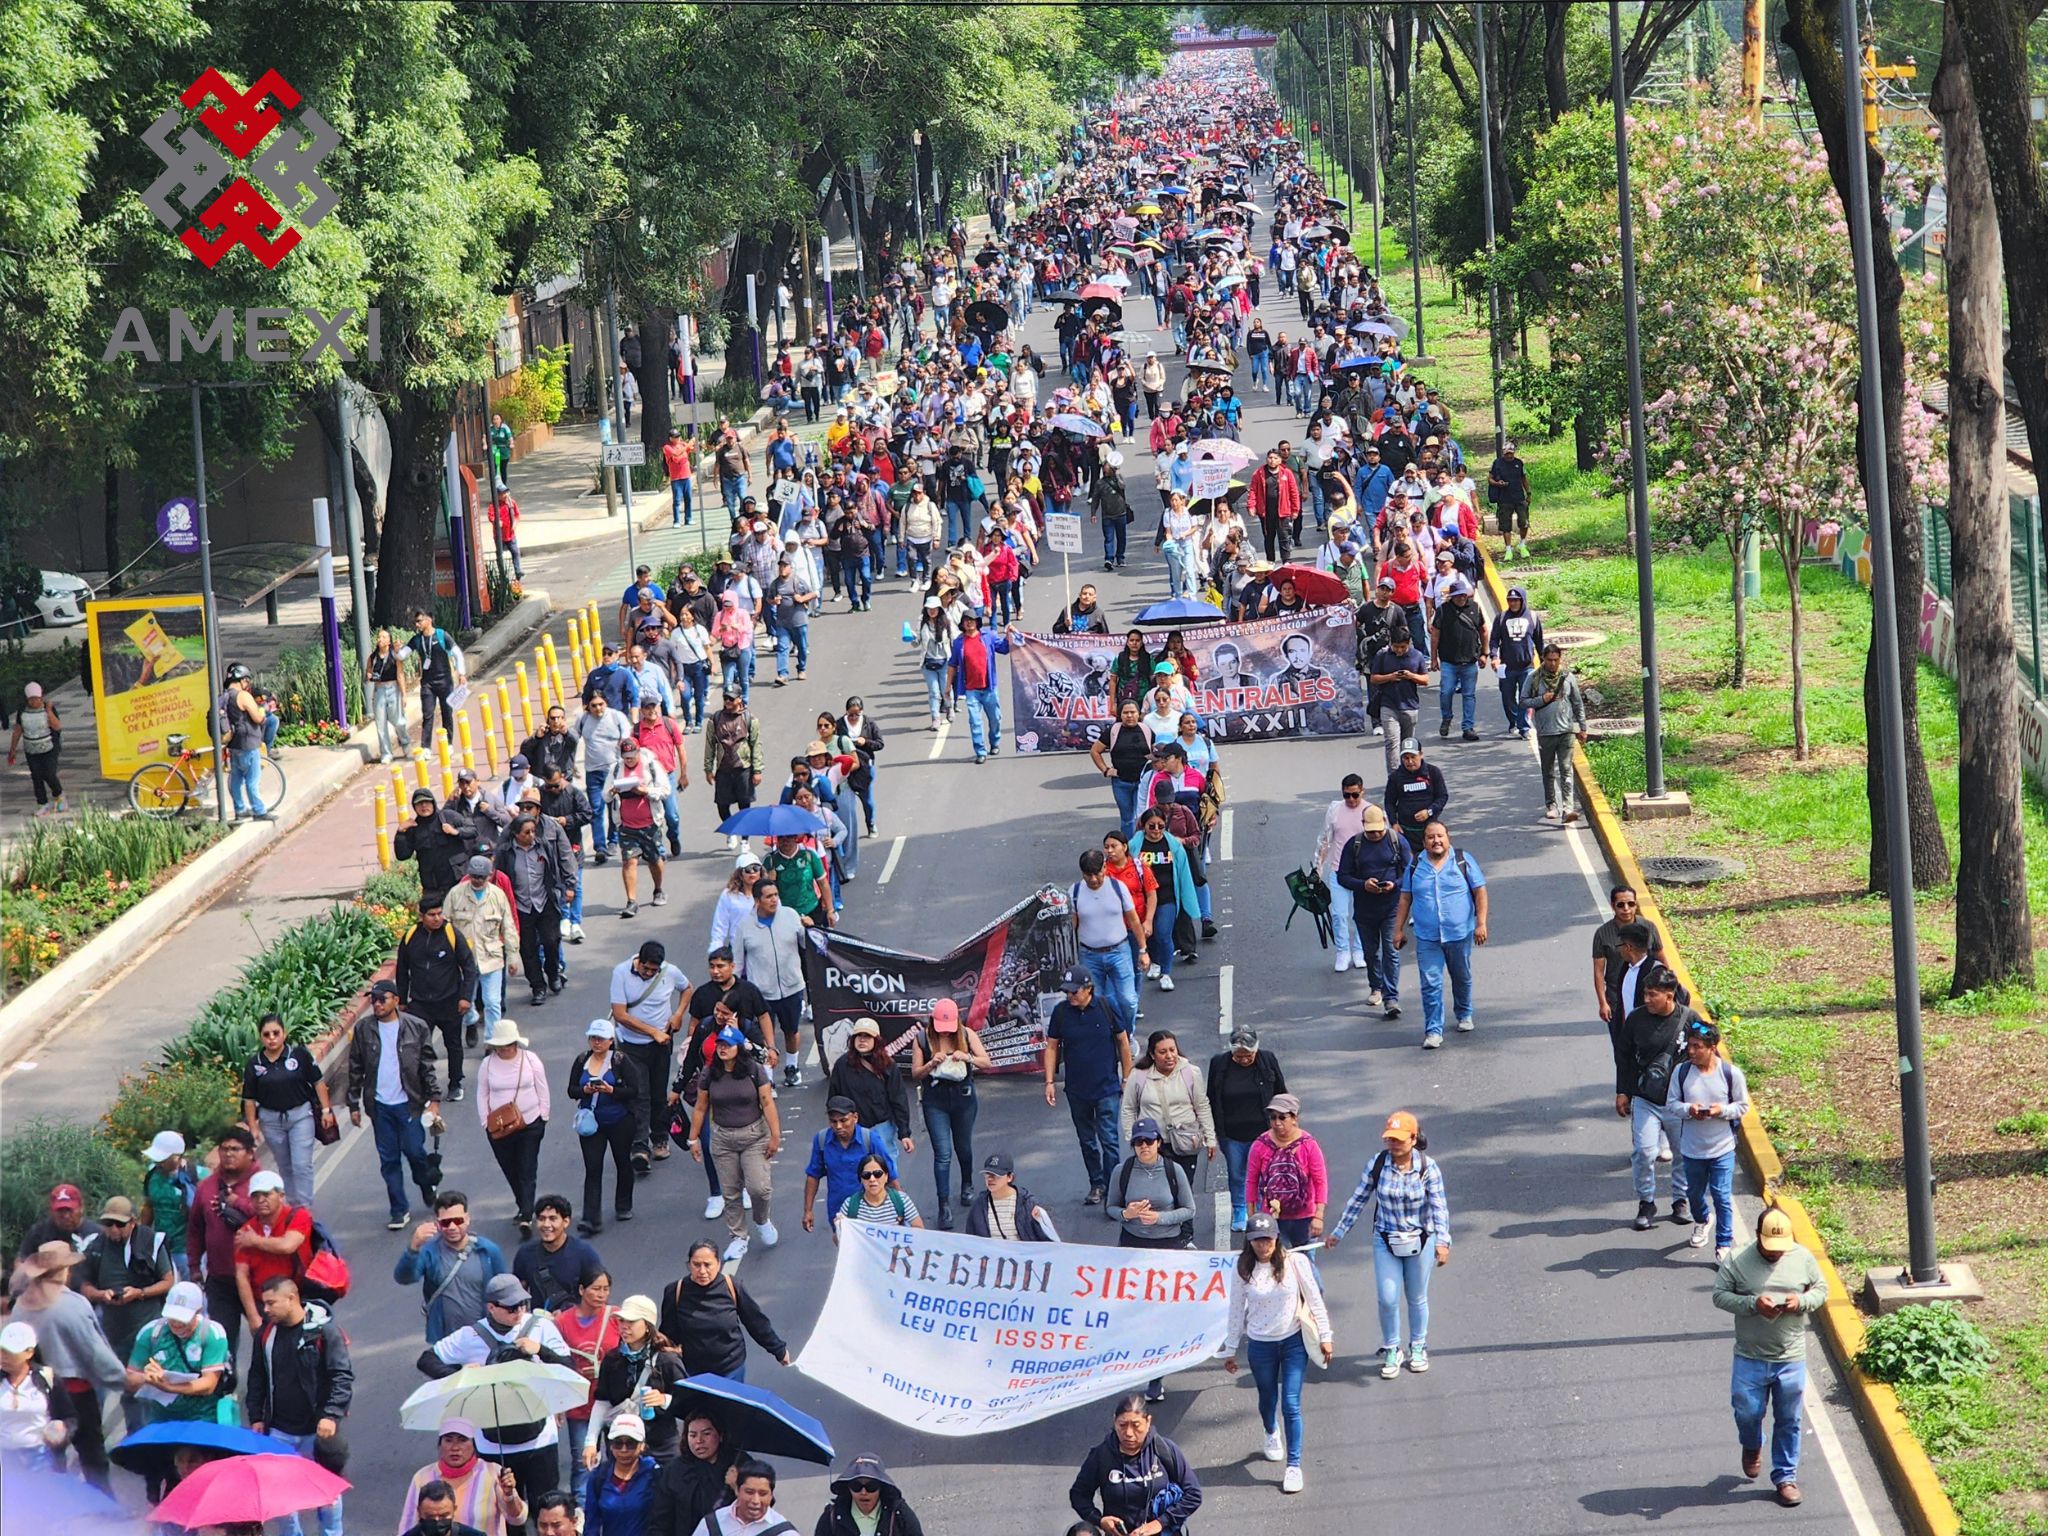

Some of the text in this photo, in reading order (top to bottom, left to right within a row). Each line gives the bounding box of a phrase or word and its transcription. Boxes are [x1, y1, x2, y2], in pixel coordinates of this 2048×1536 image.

[122, 698, 194, 725] COPA MUNDIAL
[1193, 677, 1337, 714] ENTRALES
[127, 723, 140, 734] DE
[141, 719, 155, 731] LA
[156, 713, 176, 727] FIFA
[1242, 708, 1308, 735] XXII
[1403, 781, 1428, 793] PUMA
[865, 1226, 914, 1244] CNTE
[886, 1244, 1228, 1304] REGION SIERRA
[903, 1290, 1111, 1329] ABROGACIÓN DE LA
[900, 1311, 938, 1340] LEY
[943, 1321, 979, 1344] DEL
[1009, 1332, 1206, 1376] ABROGACIÓN DE LA
[881, 1372, 974, 1411] AUMENTO
